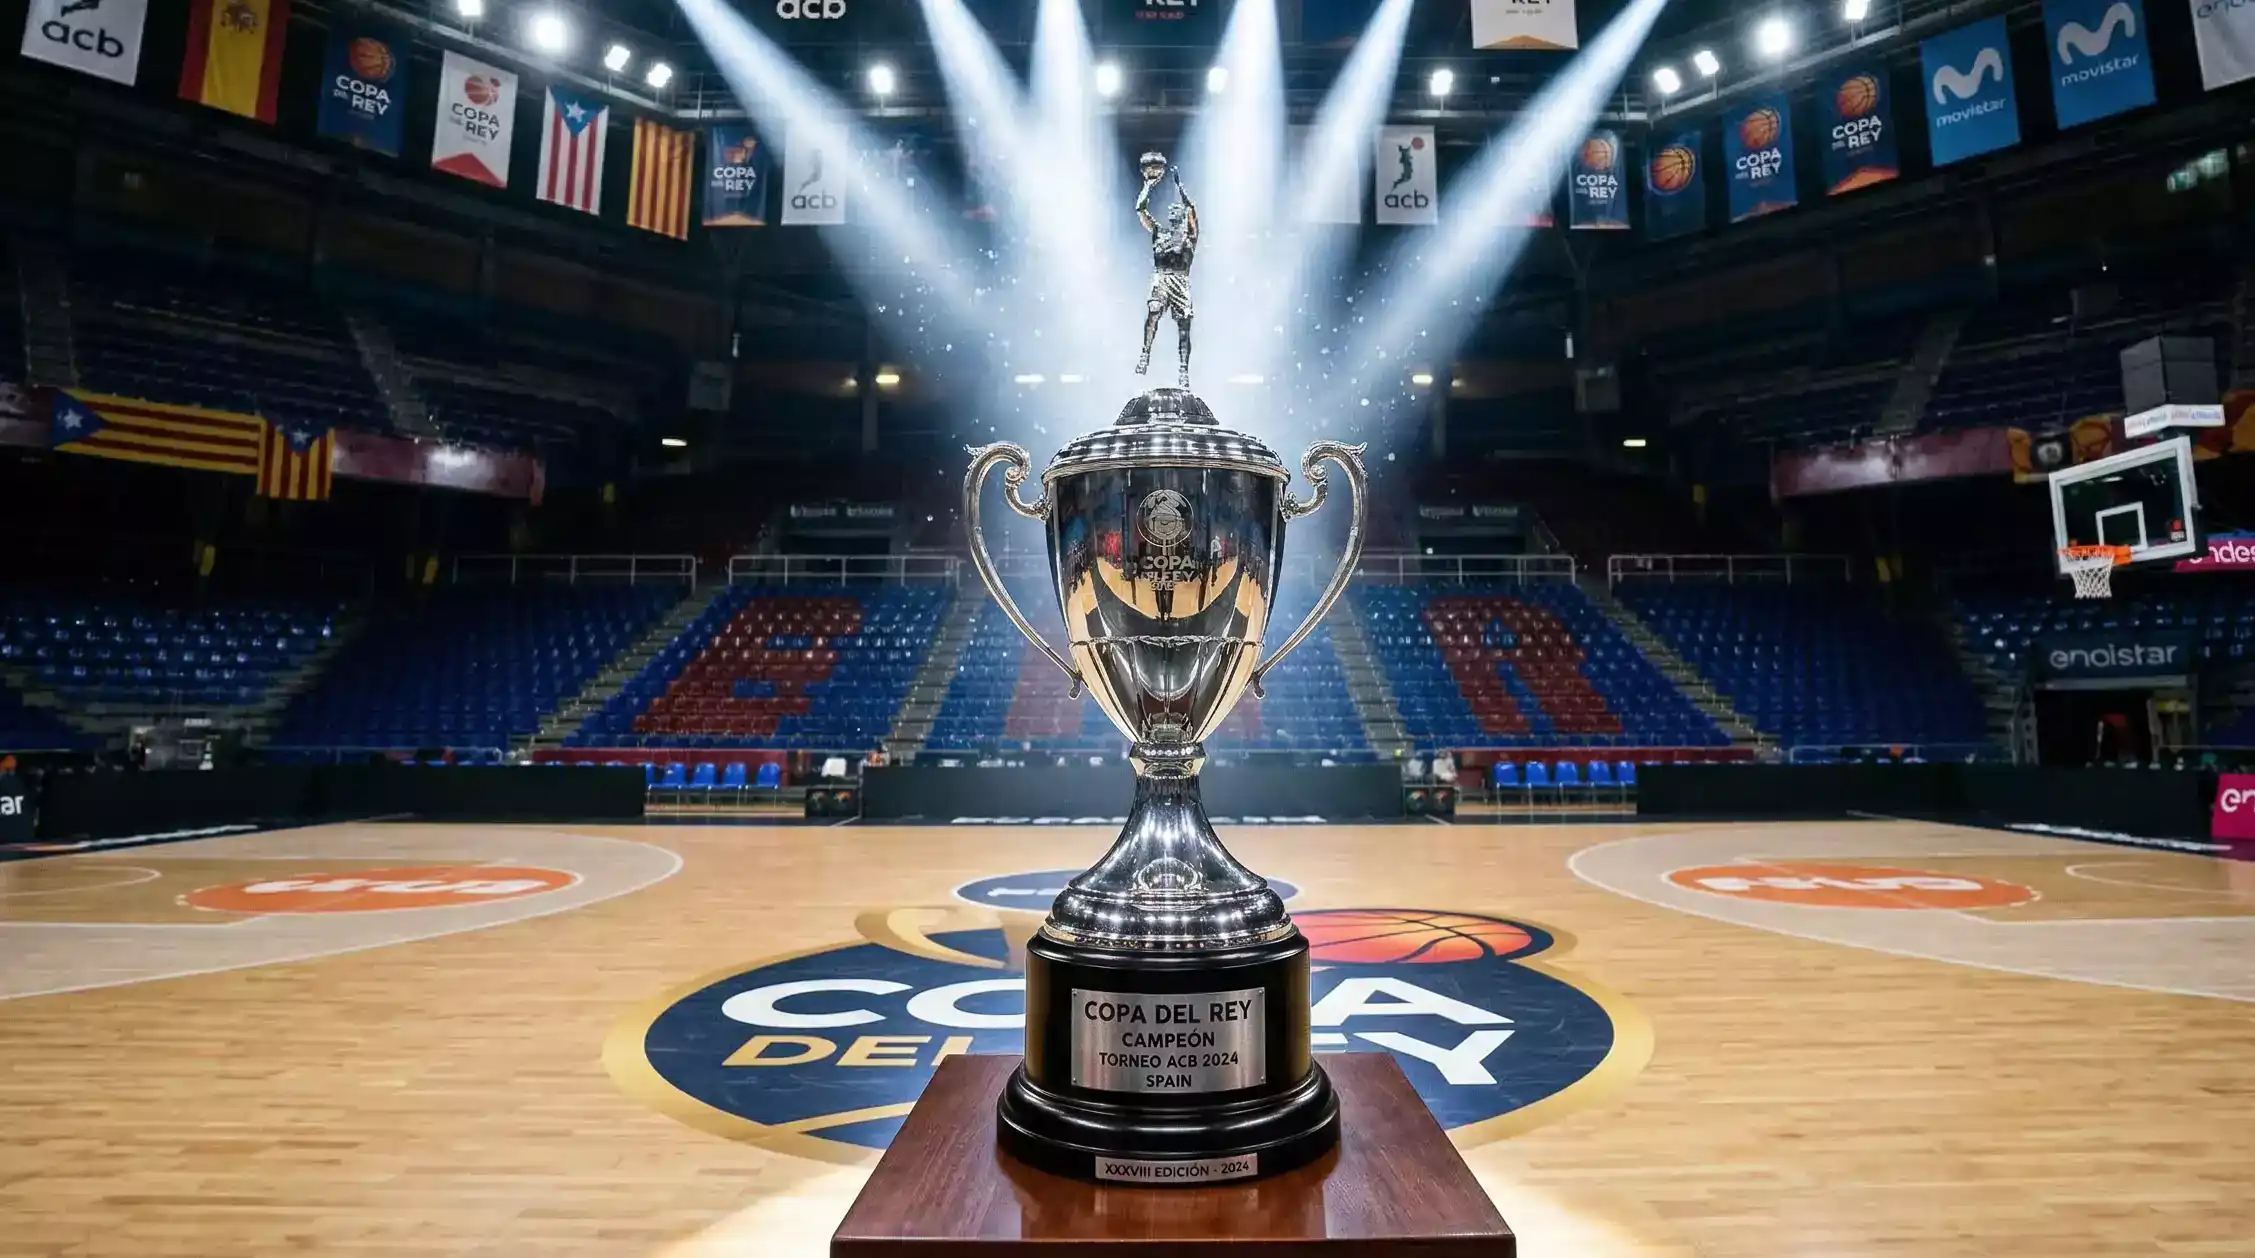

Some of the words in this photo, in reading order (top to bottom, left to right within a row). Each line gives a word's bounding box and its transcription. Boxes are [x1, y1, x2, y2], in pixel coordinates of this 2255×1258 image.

[776, 0, 846, 19] acb
[41, 20, 124, 58] acb
[2061, 51, 2139, 88] movistar
[335, 75, 391, 104] COPA
[352, 94, 388, 115] REY
[451, 102, 499, 128] COPA
[1936, 98, 2006, 128] movistar
[466, 120, 498, 141] REY
[1832, 115, 1882, 139] COPA
[1848, 127, 1882, 149] REY
[1736, 147, 1781, 170] COPA
[713, 166, 756, 178] COPA
[1576, 174, 1618, 186] COPA
[1751, 161, 1780, 180] REY
[725, 179, 756, 191] REY
[1589, 186, 1617, 199] REY
[790, 189, 838, 210] acb
[1384, 189, 1429, 209] acb
[1140, 555, 1194, 570] COPA
[2190, 541, 2255, 564] nde
[721, 978, 1516, 1029] COA
[1084, 1000, 1147, 1024] COPA
[1155, 1004, 1201, 1024] DEL
[1209, 999, 1252, 1022] REY
[1122, 1028, 1215, 1048] CAMPEÓN
[1099, 1052, 1162, 1068] TORNEO
[1166, 1054, 1198, 1068] ACB
[1202, 1051, 1239, 1067] 2024
[1146, 1075, 1192, 1088] SPAIN
[1104, 1162, 1150, 1178] XXXVIII
[1155, 1163, 1209, 1178] EDICIÓN
[1221, 1161, 1249, 1174] 2024
